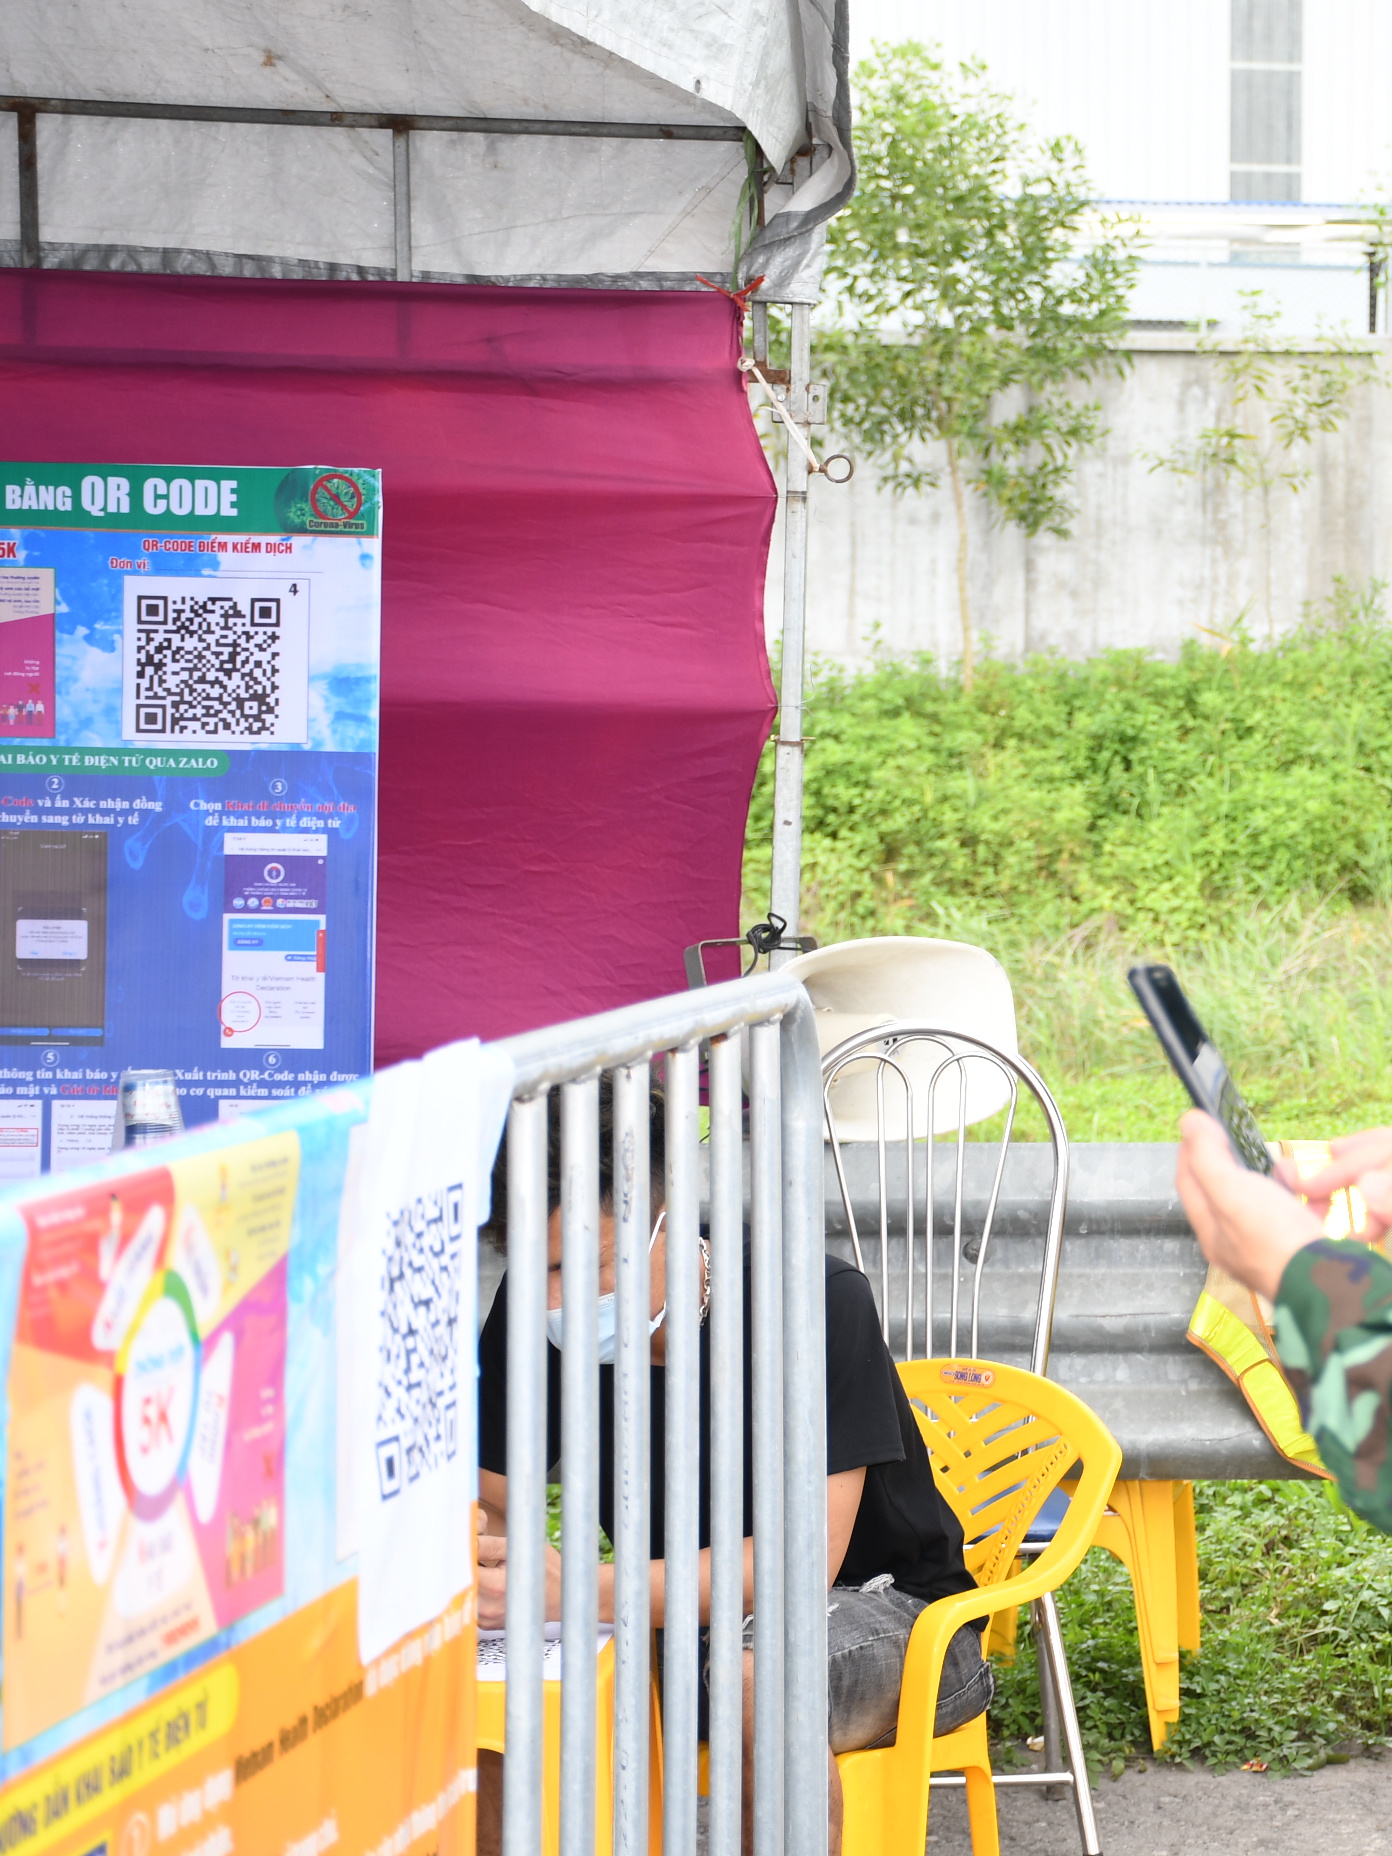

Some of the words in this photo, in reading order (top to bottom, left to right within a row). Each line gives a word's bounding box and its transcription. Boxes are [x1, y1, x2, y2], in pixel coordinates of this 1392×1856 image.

[5, 477, 73, 512] BẰNG
[81, 475, 130, 516] QR
[143, 477, 238, 517] CODE
[308, 519, 365, 530] Corona-Virus
[143, 539, 195, 552] QR-CODE
[198, 537, 228, 553] ĐIỂM
[232, 537, 262, 554] KIỂM
[266, 542, 293, 556] DỊCH
[109, 557, 132, 570] Đơn
[136, 560, 150, 572] vị:
[289, 583, 299, 597] 4
[16, 752, 47, 765] BÁO
[50, 755, 60, 766] Y
[84, 754, 119, 768] ĐIỆN
[145, 757, 176, 770] QUA
[179, 758, 218, 769] ZALO
[51, 778, 59, 789] 2
[274, 782, 283, 793] 3
[37, 797, 51, 808] và
[73, 798, 97, 808] Xác
[100, 798, 130, 812] nhận
[132, 796, 163, 812] đồng
[190, 800, 222, 813] Chọn
[42, 814, 70, 826] sang
[88, 814, 114, 825] khai
[117, 816, 126, 827] y
[222, 816, 248, 827] khai
[252, 816, 273, 827] báo
[276, 819, 284, 830] y
[300, 816, 325, 830] điện
[46, 1053, 54, 1063] 5
[269, 1055, 276, 1064] 6
[56, 1068, 82, 1080] khai
[86, 1068, 108, 1080] báo
[110, 1072, 118, 1082] y
[175, 1066, 204, 1080] Xuất
[240, 1070, 295, 1082] QR-Code
[298, 1070, 326, 1084] nhận
[43, 1084, 58, 1094] và
[206, 1088, 237, 1098] quan
